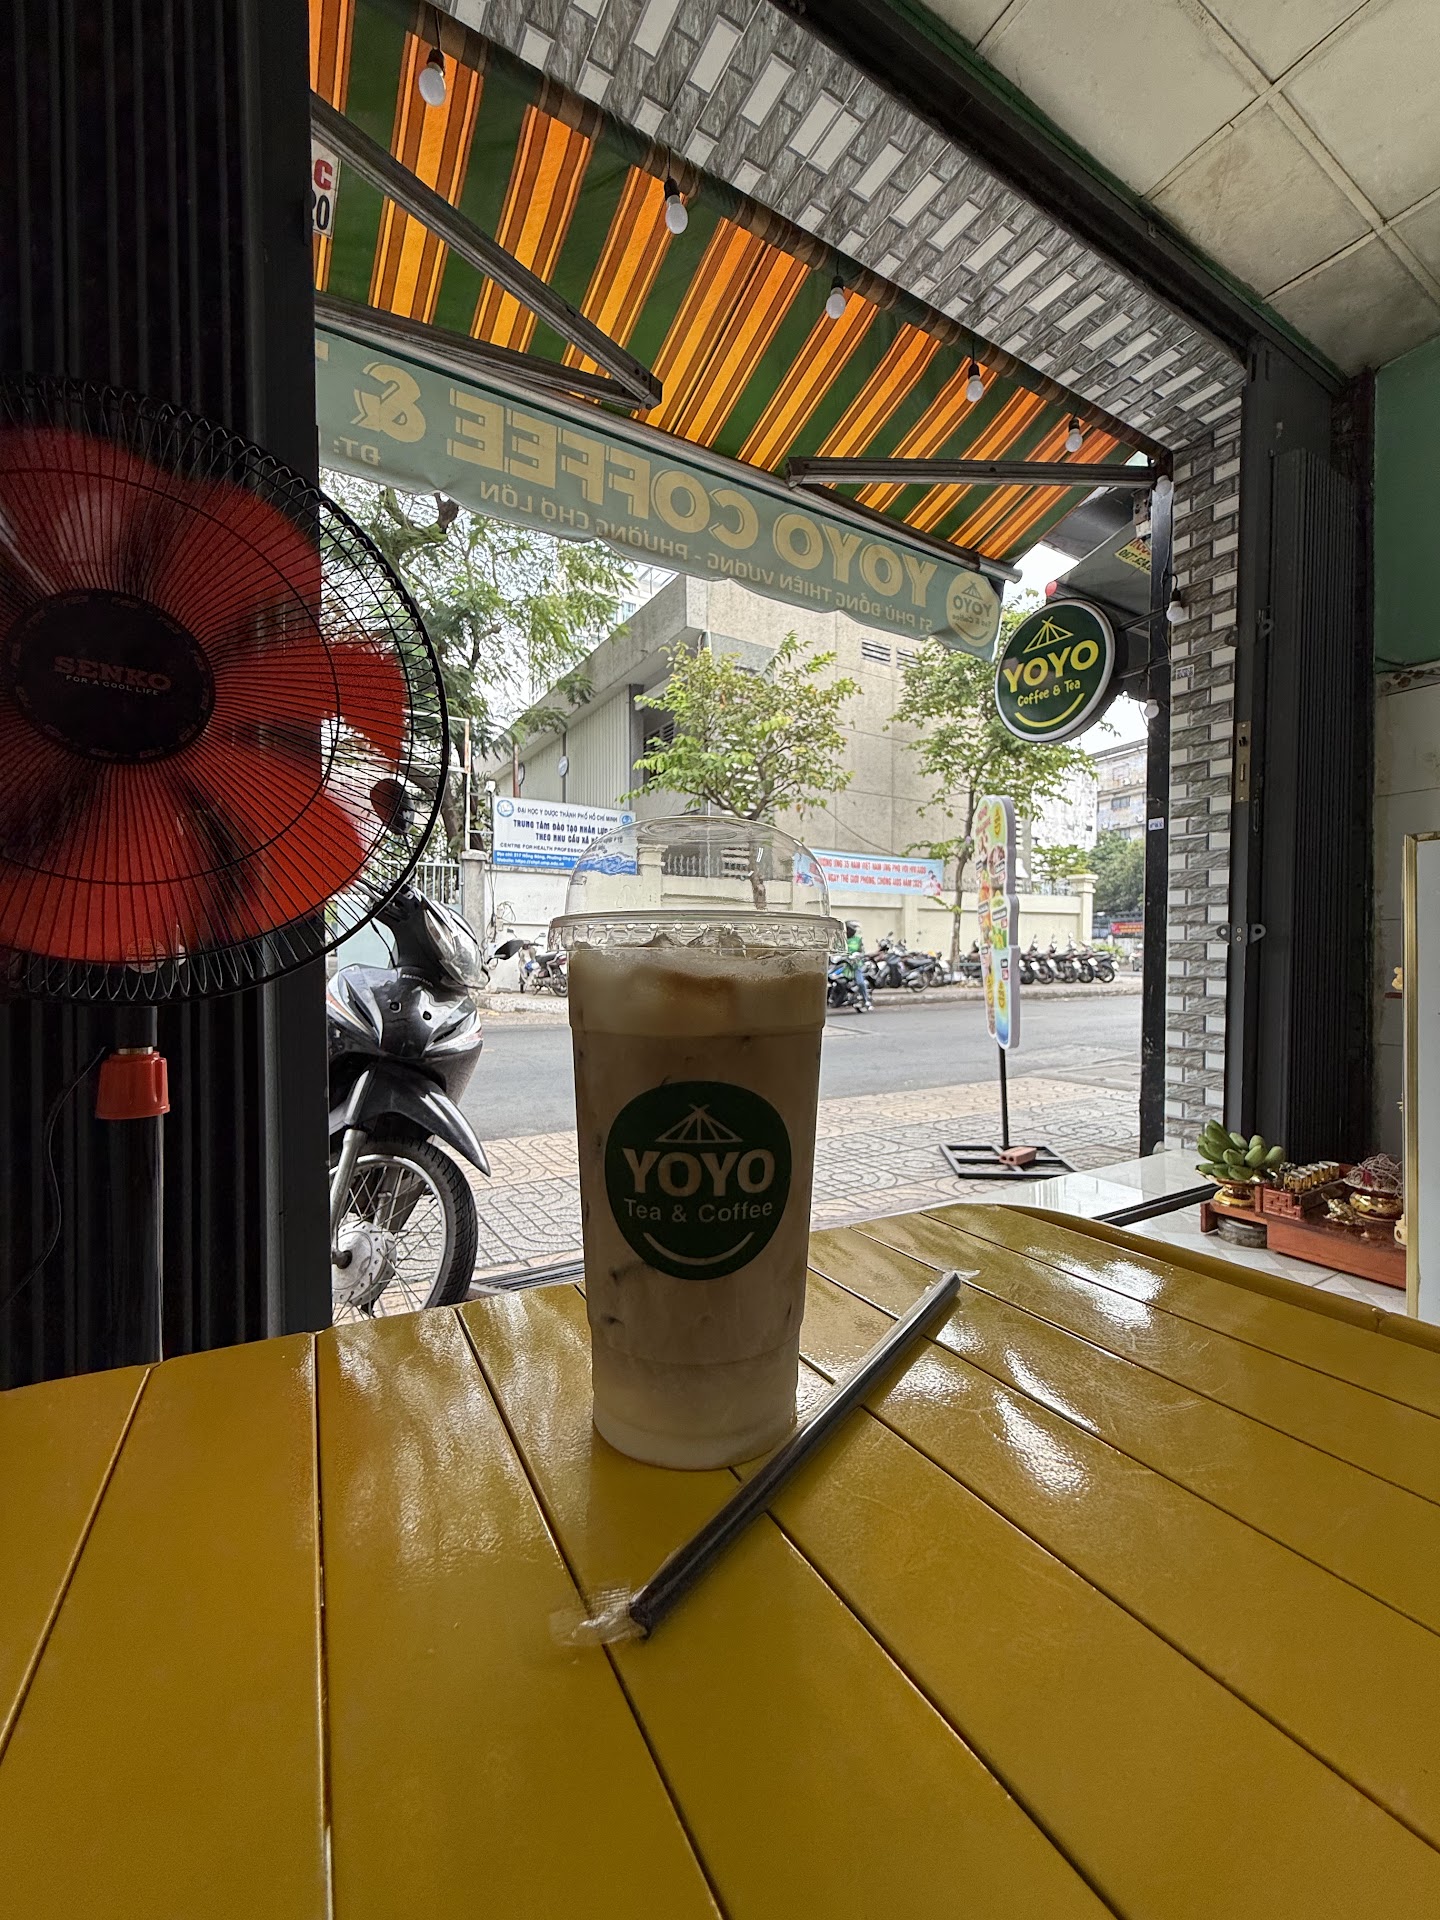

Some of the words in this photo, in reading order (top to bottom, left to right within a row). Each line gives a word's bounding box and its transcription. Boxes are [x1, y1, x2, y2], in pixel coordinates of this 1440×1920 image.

[54, 655, 171, 690] SENKO
[1003, 639, 1099, 693] YOYO
[66, 675, 88, 683] FOR
[103, 681, 132, 691] COOL
[135, 687, 159, 696] LIFE
[1018, 689, 1049, 707] Coffee
[1053, 685, 1061, 696] &
[1064, 679, 1081, 693] Tea
[513, 819, 534, 829] TRUNG
[536, 820, 550, 830] TÂM
[566, 824, 577, 833] TẠO
[580, 825, 595, 834] NHÂN
[535, 833, 551, 841] THEO
[622, 1147, 776, 1197] YOYO
[624, 1198, 662, 1221] Tea
[672, 1204, 687, 1223] &
[699, 1202, 773, 1223] Coffee
